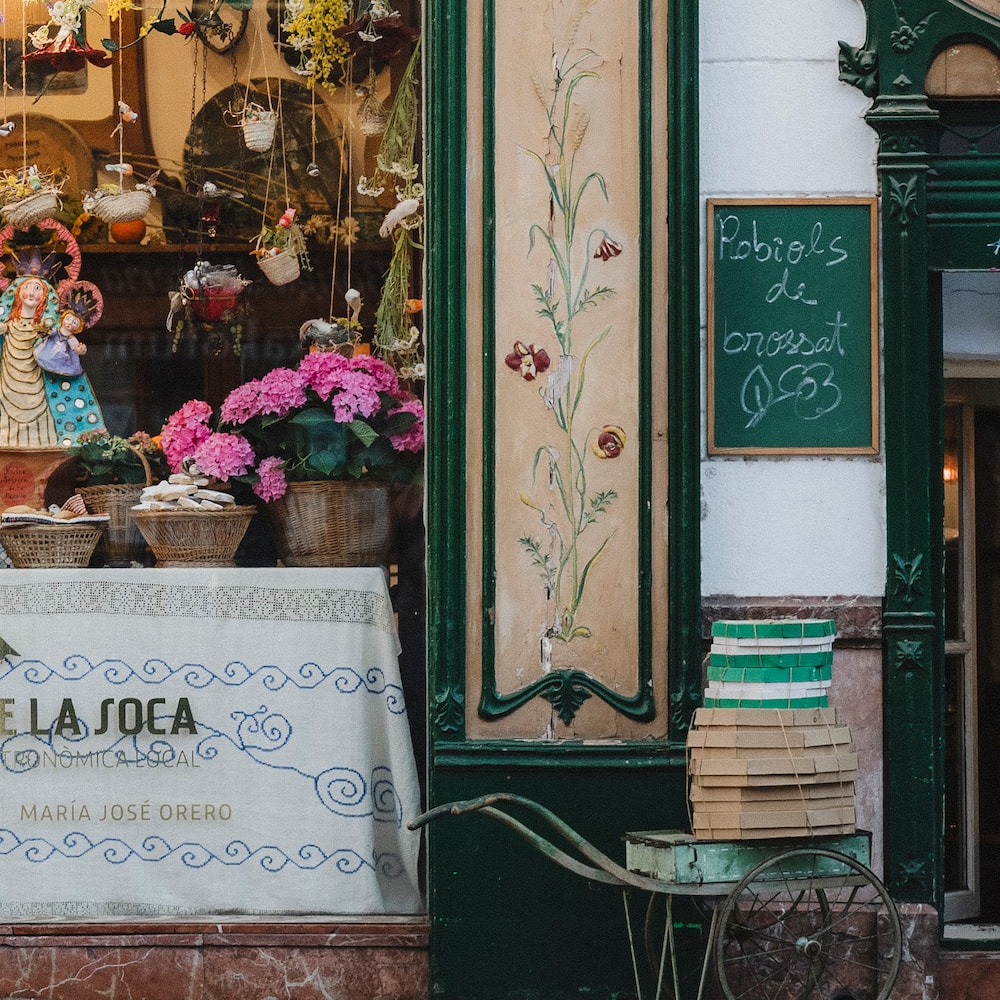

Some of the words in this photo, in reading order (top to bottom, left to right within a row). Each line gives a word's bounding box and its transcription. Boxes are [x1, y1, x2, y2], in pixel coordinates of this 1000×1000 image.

[717, 213, 849, 267] Robiols
[765, 267, 818, 305] de
[722, 310, 849, 357] brossat
[30, 697, 82, 736] LA
[94, 696, 198, 736] SOCA
[136, 749, 201, 769] LOCAL
[20, 799, 91, 822] MARÍA
[98, 799, 151, 822] JOSÉ
[160, 803, 233, 822] ORERO
